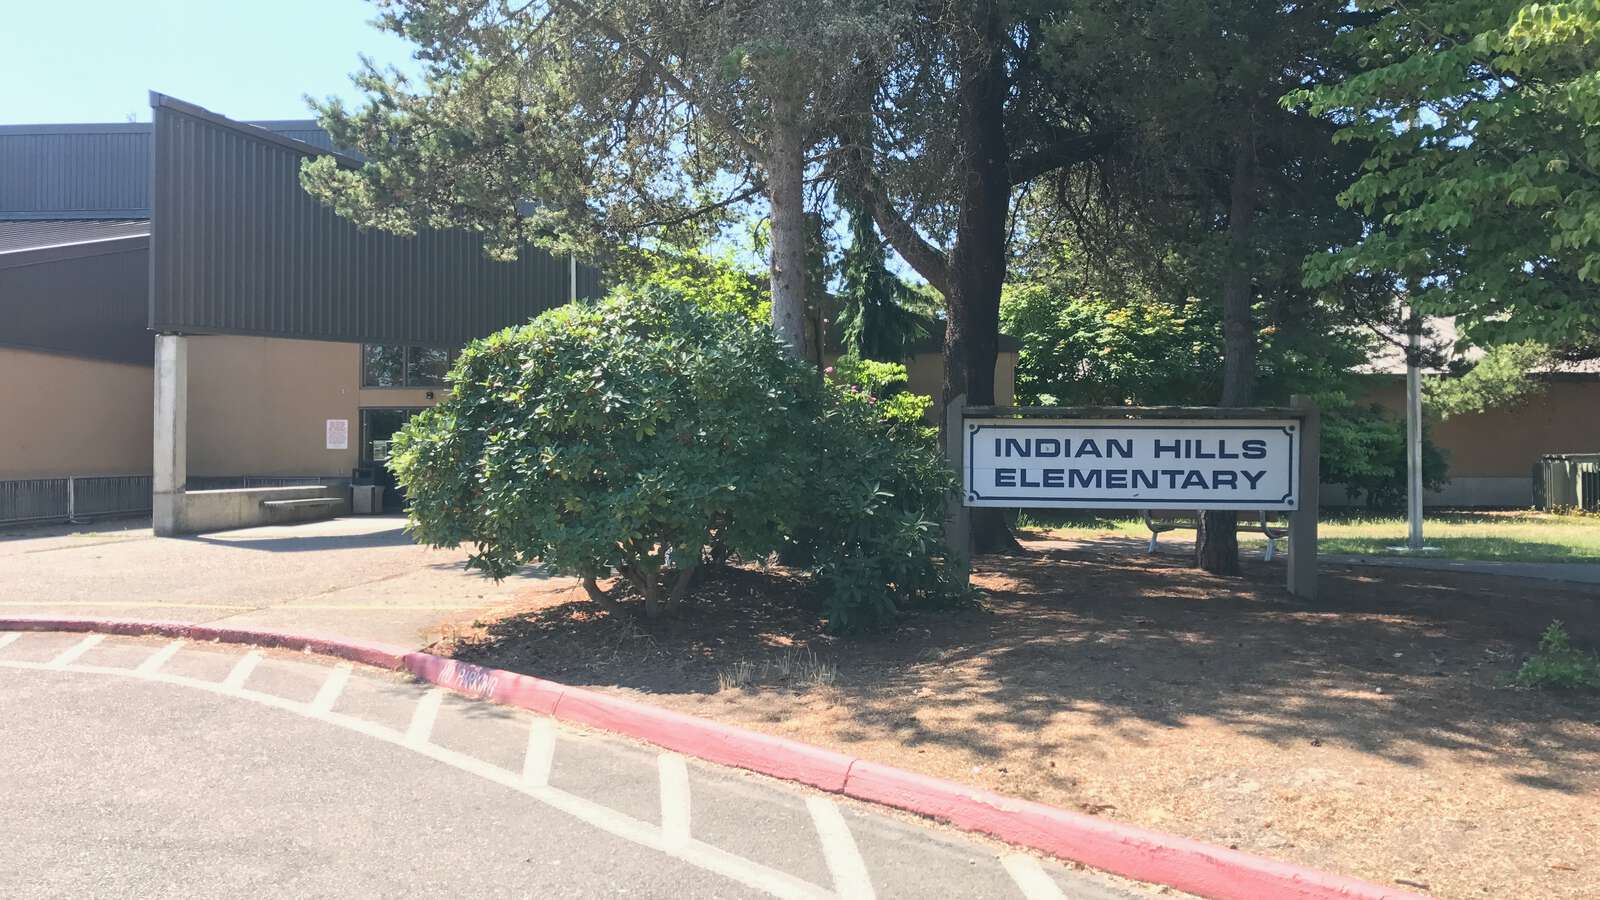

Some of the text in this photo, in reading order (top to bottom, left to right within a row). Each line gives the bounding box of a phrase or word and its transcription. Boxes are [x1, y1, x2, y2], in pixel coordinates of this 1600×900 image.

[994, 438, 1267, 459] INDIAN HILLS
[995, 467, 1267, 490] ELEMENTARY
